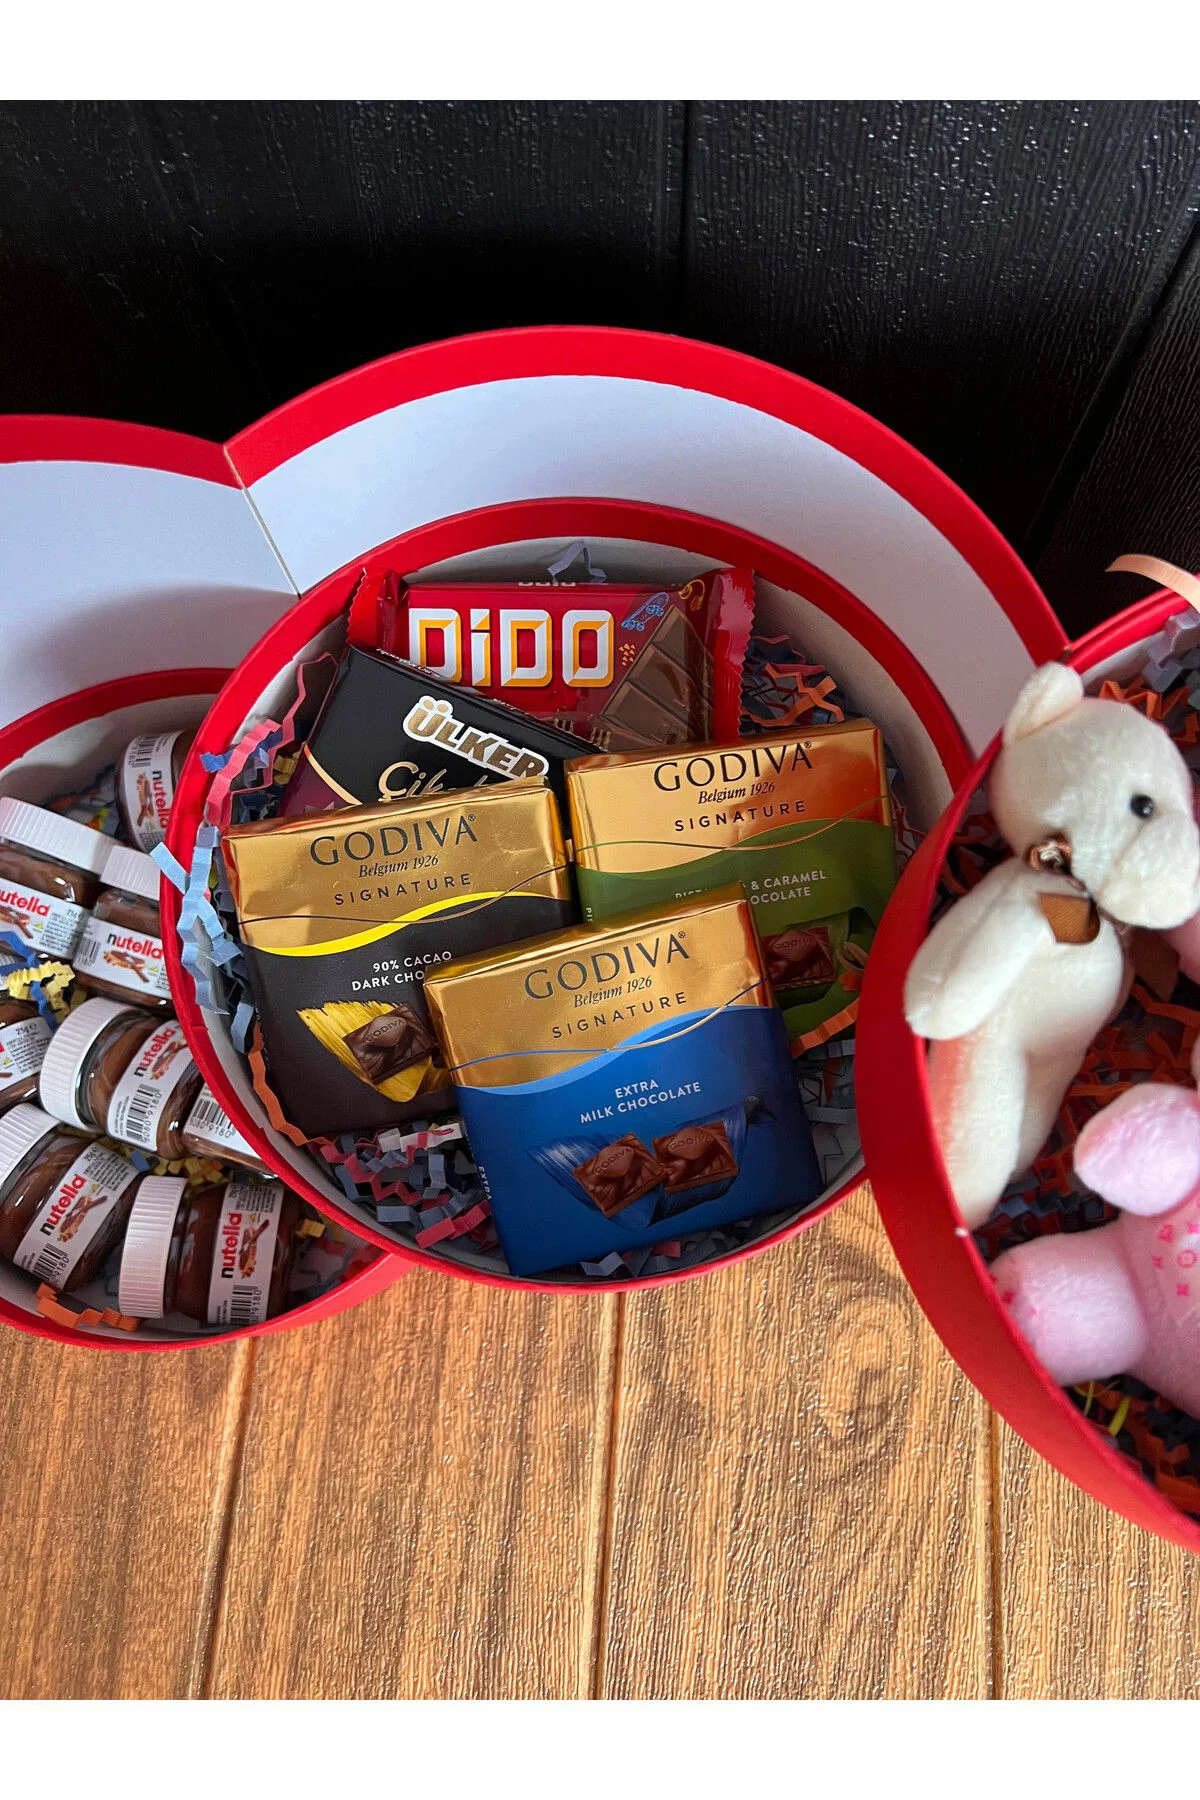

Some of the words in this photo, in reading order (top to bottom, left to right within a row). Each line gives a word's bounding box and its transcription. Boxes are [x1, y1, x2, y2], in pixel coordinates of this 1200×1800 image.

[408, 608, 614, 687] DiDO
[403, 695, 549, 779] ÜLKER
[654, 743, 812, 791] GODIVA
[153, 770, 171, 829] nutella
[698, 787, 746, 804] Belgium
[750, 781, 775, 795] 1926
[675, 801, 805, 831] SIGNATURE
[310, 814, 478, 865] GODIVA
[359, 861, 408, 878] Belgium
[413, 854, 439, 868] 1926
[751, 880, 760, 891] &
[764, 870, 827, 888] CARAMEL
[0, 890, 50, 917] utella
[335, 874, 471, 905] SIGNATURE
[751, 887, 812, 905] OCOLATE
[107, 933, 163, 959] nutella
[373, 959, 399, 973] 90%
[404, 951, 453, 967] CACAO
[352, 976, 390, 991] DARK
[395, 970, 425, 984] CHO
[525, 933, 690, 1000] GODIVA
[574, 987, 623, 1008] Belgium
[626, 975, 652, 994] 1926
[552, 992, 687, 1038] SIGNATURE
[134, 1028, 177, 1077] nutella
[580, 1106, 613, 1123] MILK
[617, 1081, 702, 1113] CHOCOLATE
[615, 1079, 659, 1099] EXTRA
[40, 1174, 87, 1236] nutella
[221, 1212, 243, 1279] nutella
